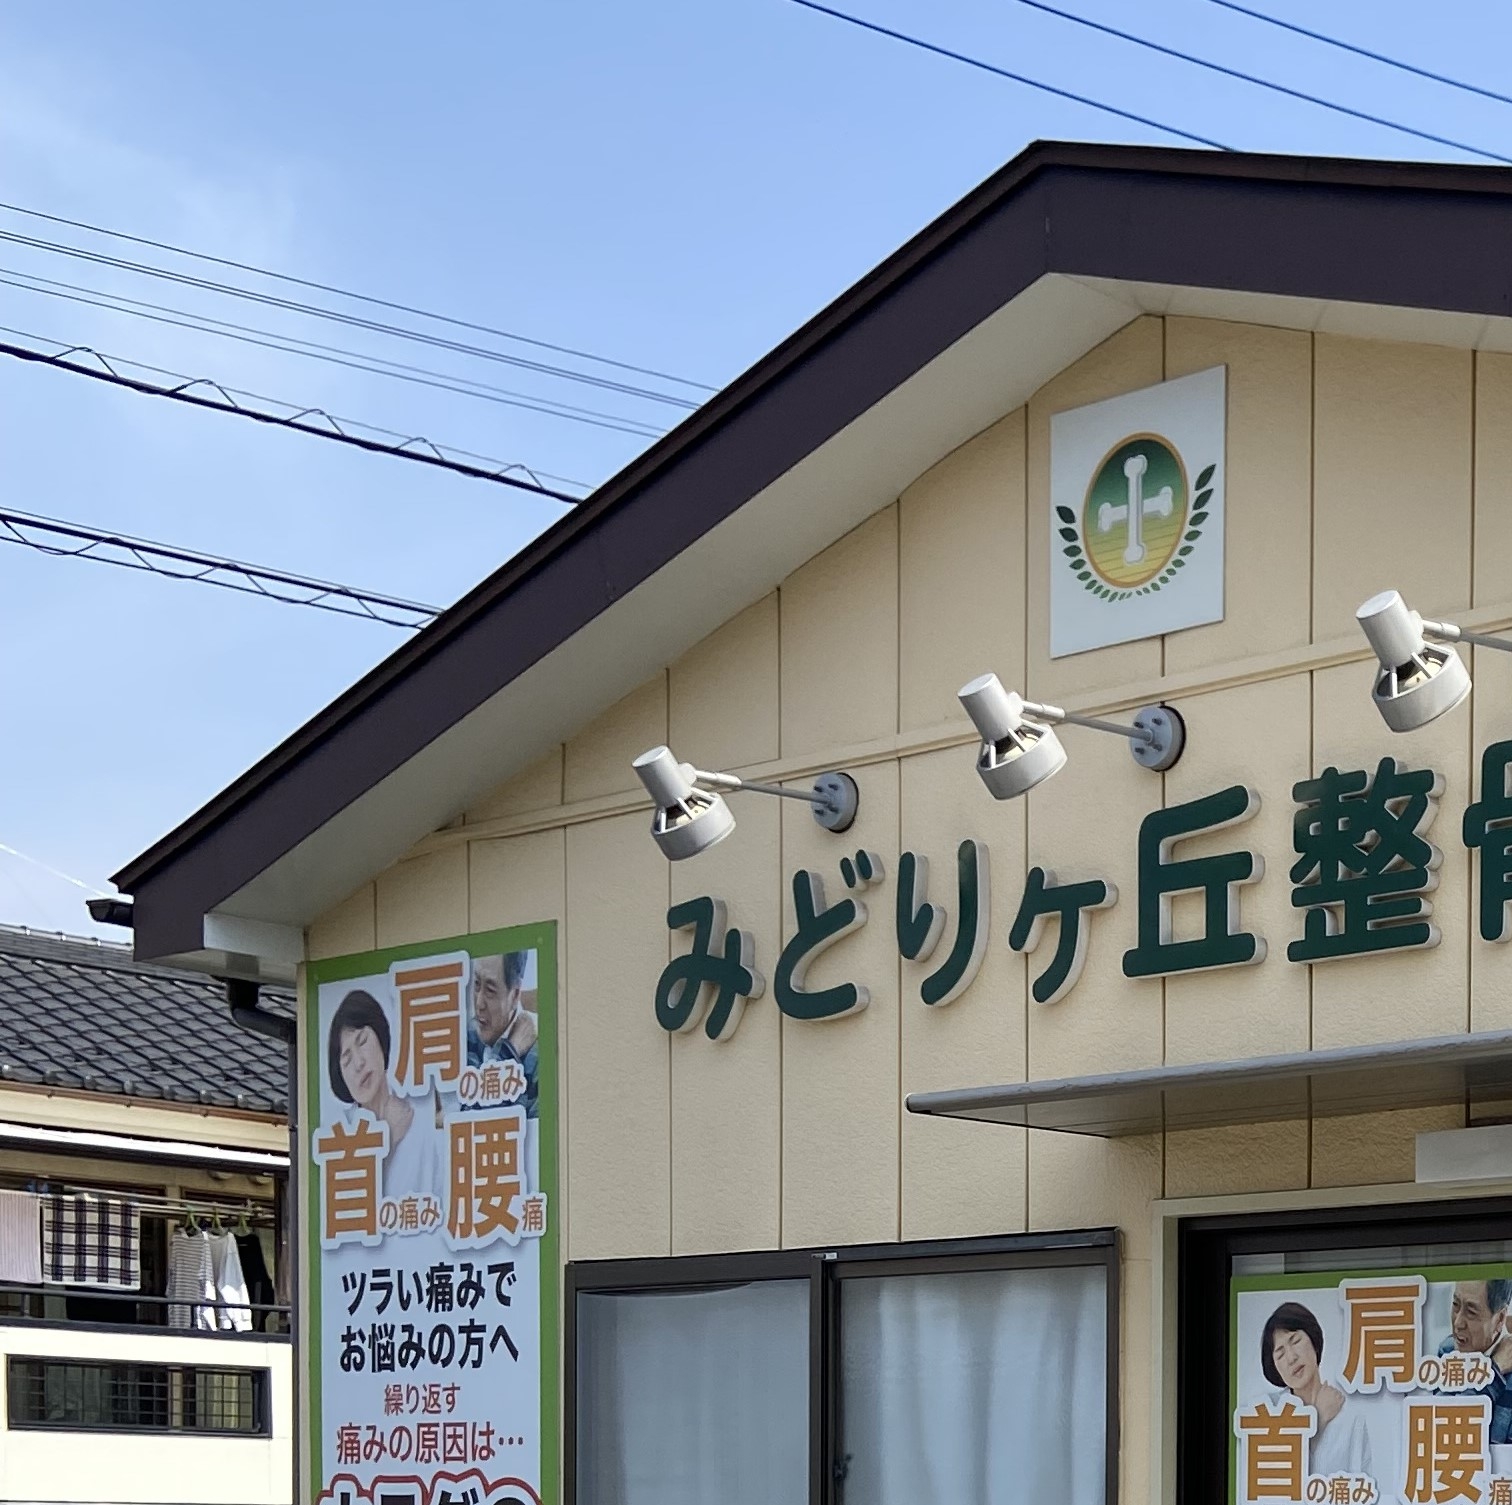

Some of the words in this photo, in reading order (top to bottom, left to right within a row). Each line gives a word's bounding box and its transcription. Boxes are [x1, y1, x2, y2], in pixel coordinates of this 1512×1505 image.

[394, 962, 525, 1098] 肩の痛み
[318, 1118, 441, 1240] 首の痛み
[446, 1115, 543, 1240] 腰痛
[341, 1260, 517, 1316] ツラい痛みで
[1342, 1283, 1492, 1388] 肩の痛み
[340, 1318, 519, 1373] お悩みの方へ
[384, 1382, 461, 1417] 繰り返す
[1240, 1402, 1374, 1505] 首の痛み
